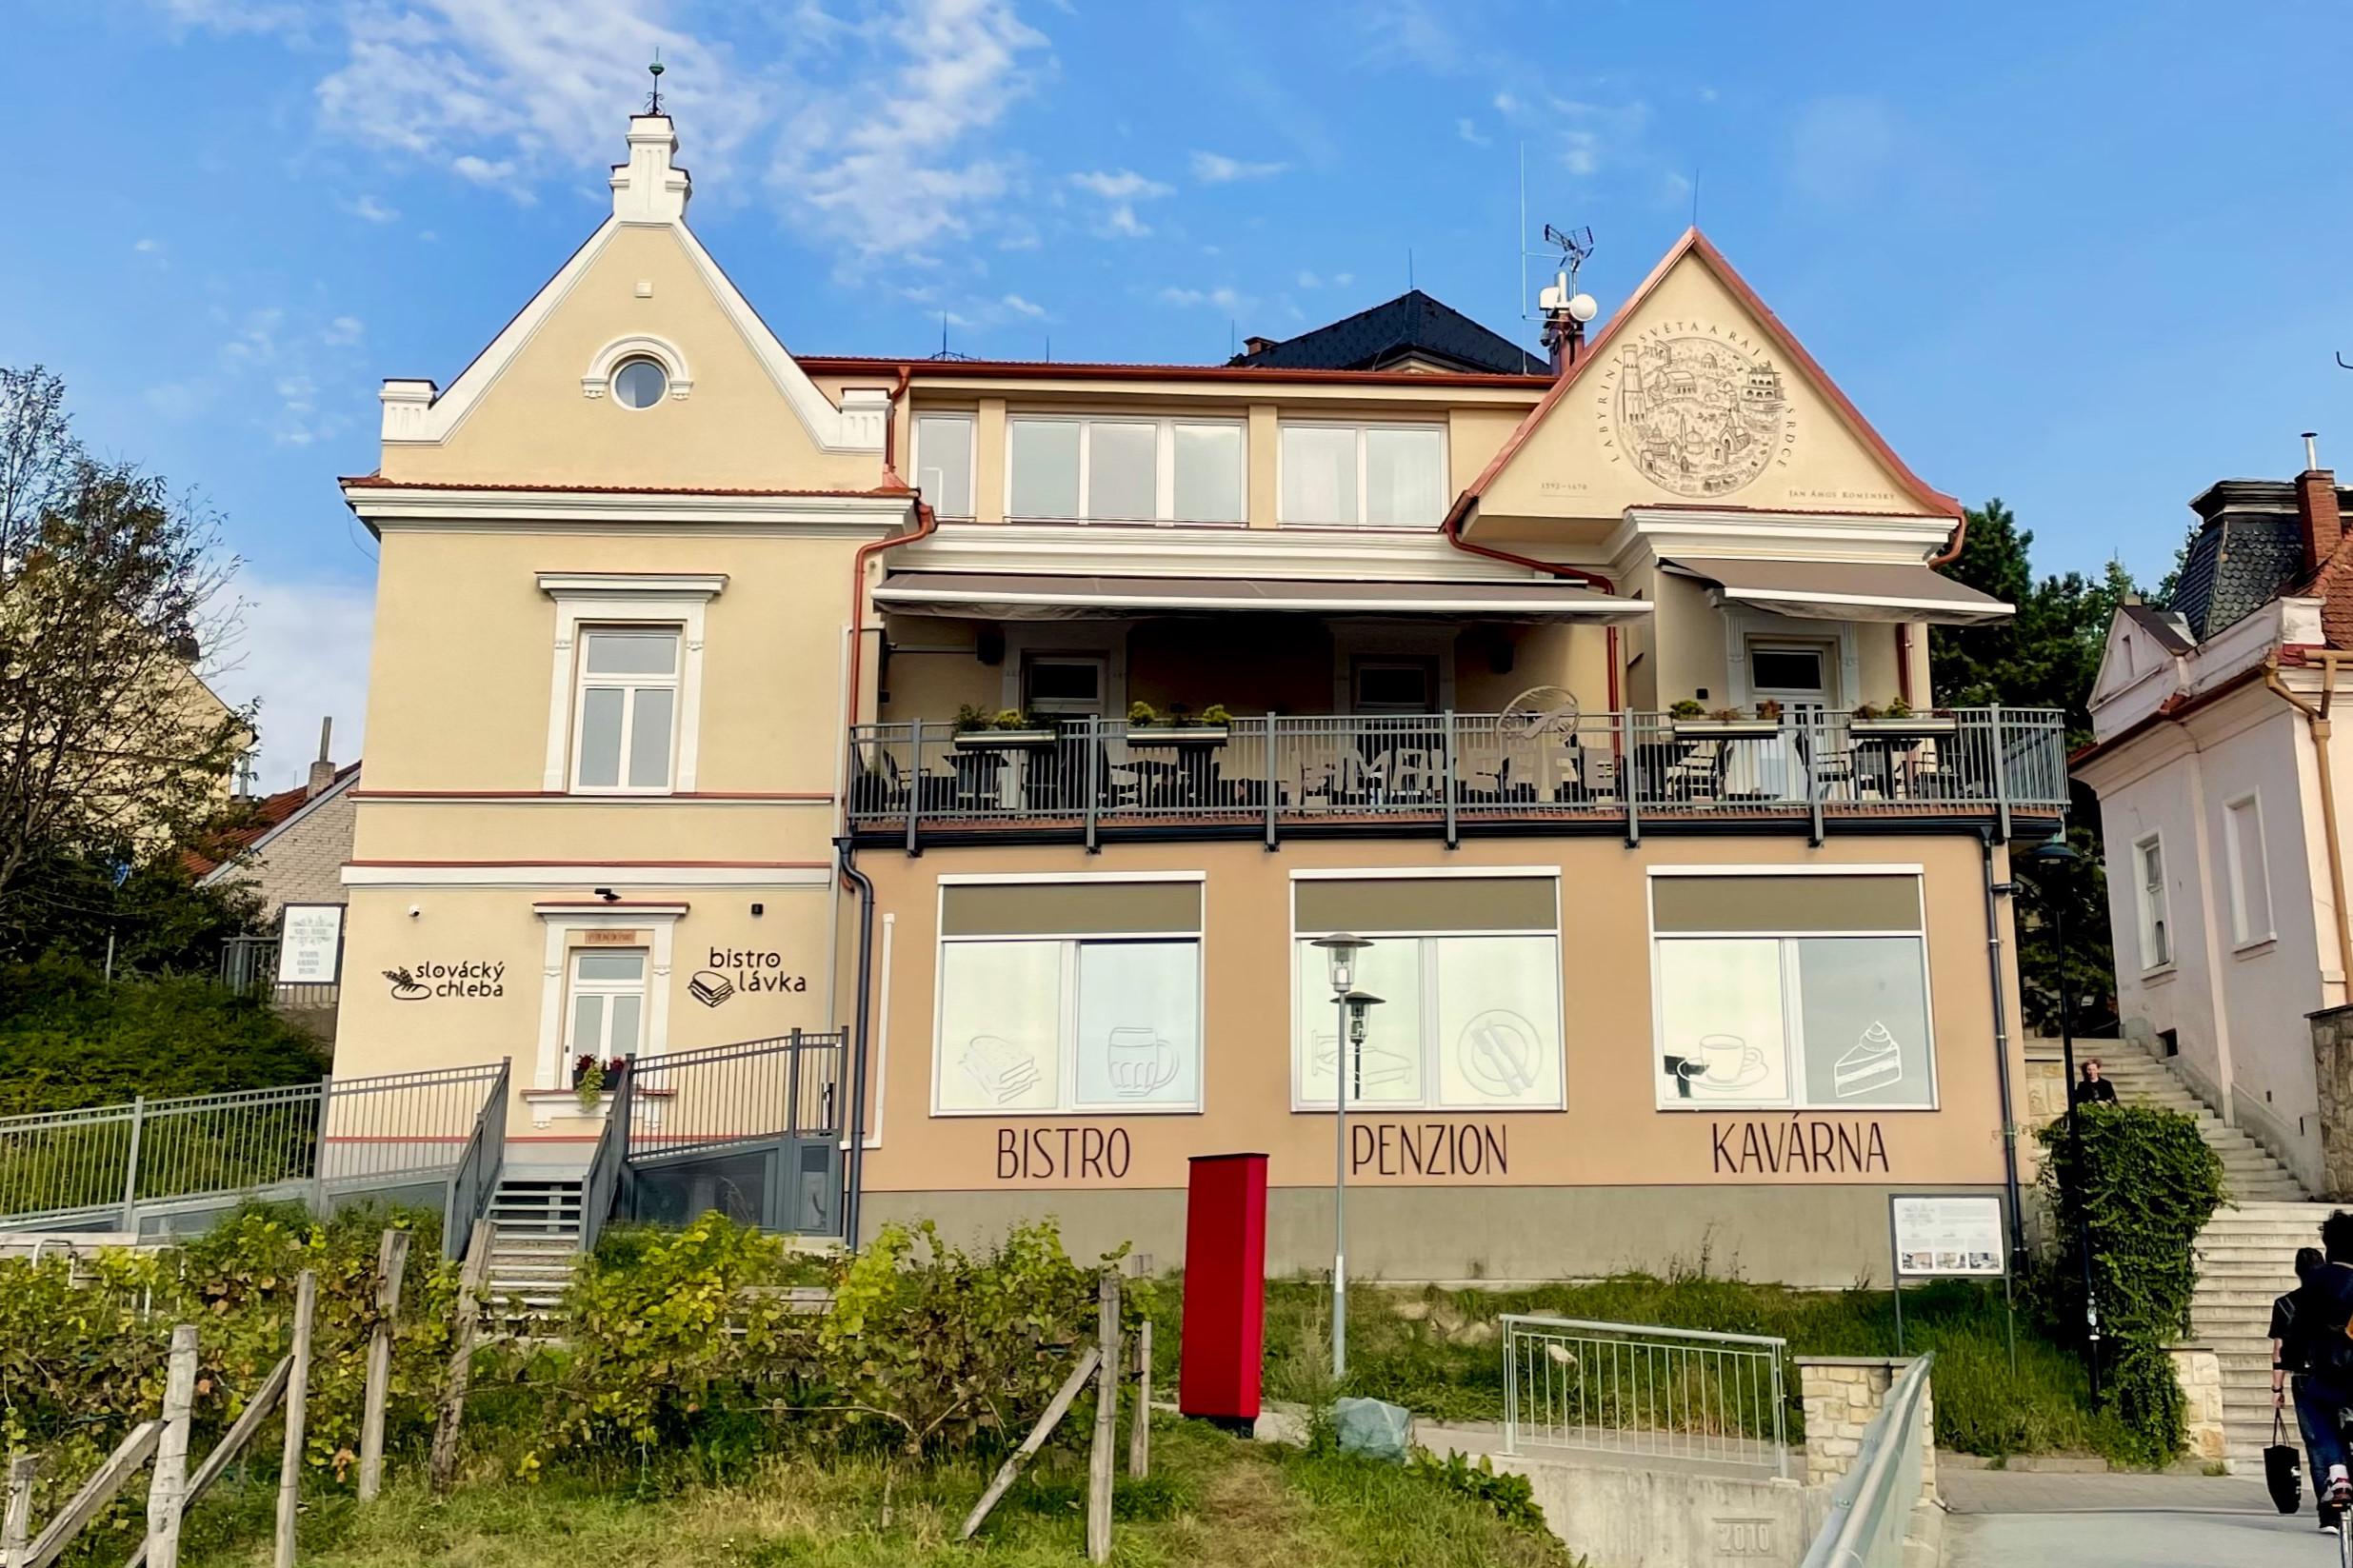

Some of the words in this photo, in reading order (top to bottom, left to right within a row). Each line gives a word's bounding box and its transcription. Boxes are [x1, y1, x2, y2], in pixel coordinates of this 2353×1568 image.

[1597, 357, 1624, 463] LABYRINT
[1708, 325, 1718, 334] A
[1775, 407, 1797, 467] SRDCE
[709, 946, 781, 968] bistro
[415, 961, 505, 982] slovácký
[739, 970, 807, 992] lávka
[436, 980, 503, 997] chleba
[998, 1127, 1130, 1179] BISTRO
[1352, 1124, 1507, 1175] PENZION
[1712, 1111, 1889, 1173] KAVÁRNA
[1717, 1524, 1770, 1552] 2010
